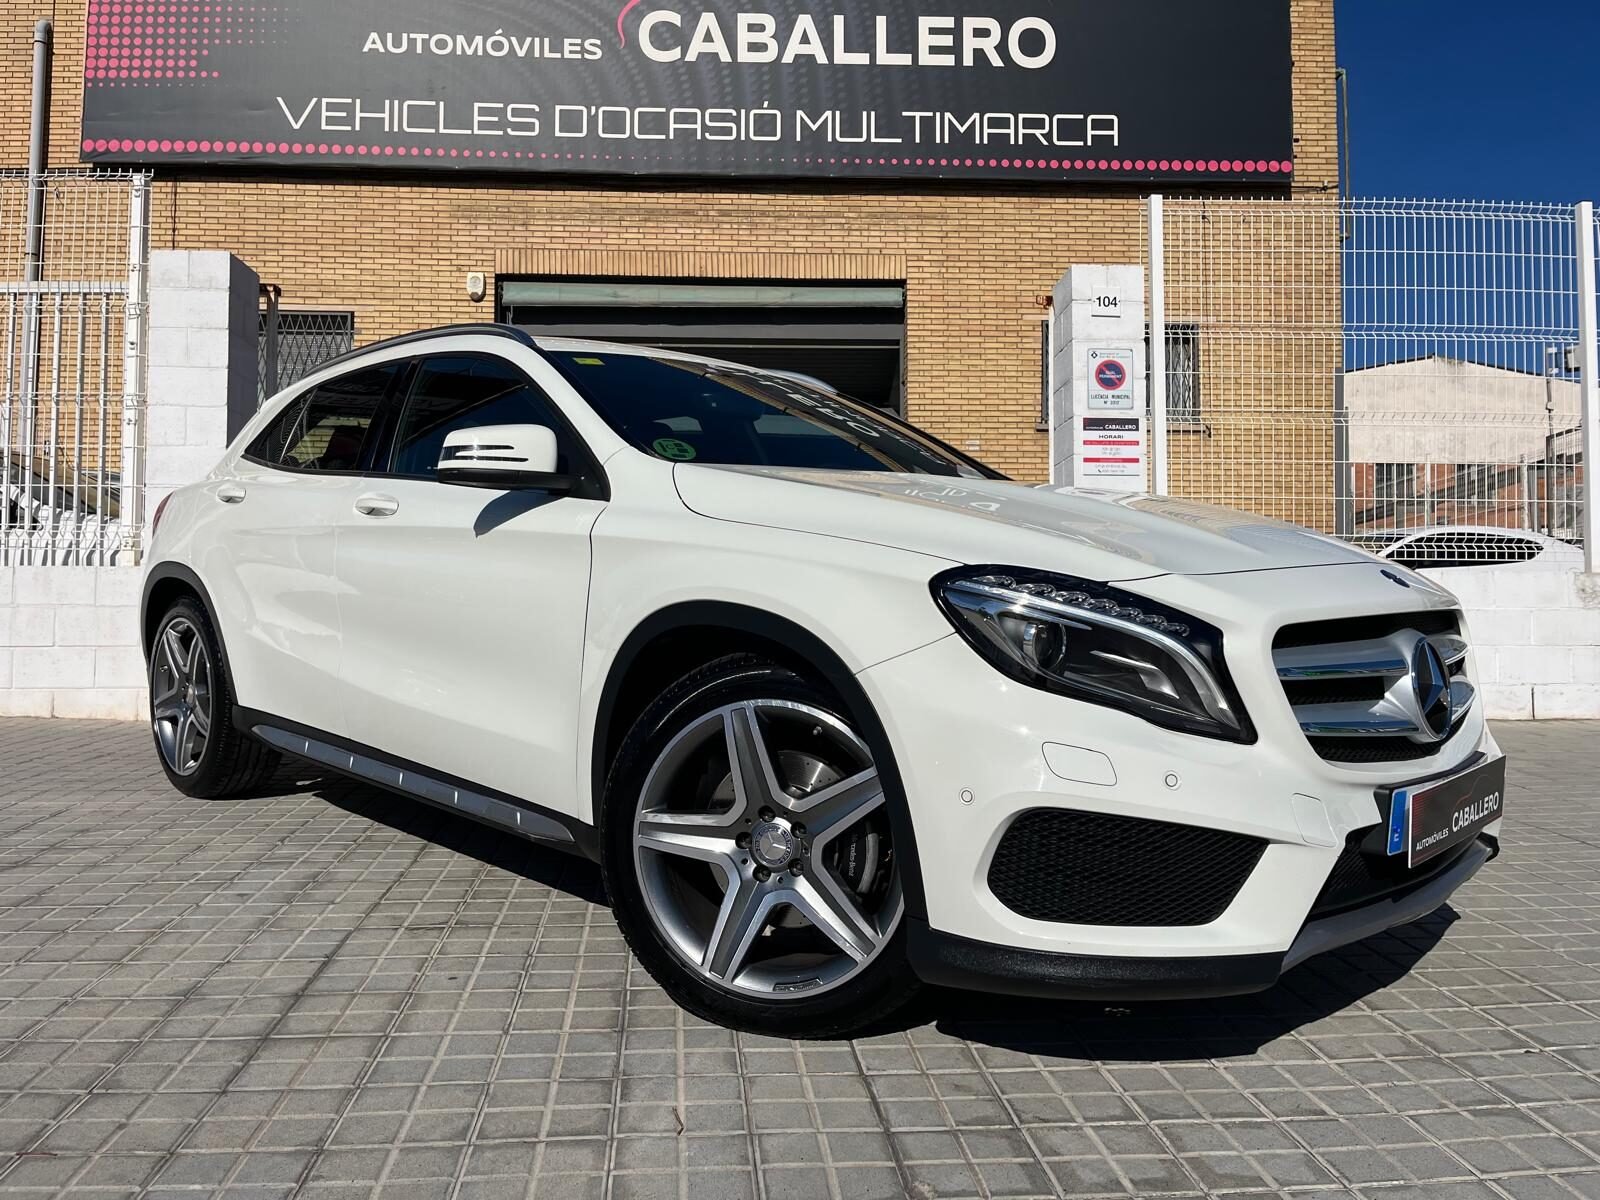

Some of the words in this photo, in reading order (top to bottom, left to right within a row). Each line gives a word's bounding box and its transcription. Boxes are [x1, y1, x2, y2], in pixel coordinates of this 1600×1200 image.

[361, 28, 603, 60] AUTOMÓVILES
[638, 9, 1057, 69] CABALLERO
[276, 96, 540, 137] VEHICLES
[554, 100, 782, 141] D'OCASIÓ
[796, 109, 1119, 146] MULTIMARCA
[1096, 295, 1118, 308] 104
[1416, 827, 1449, 850] AUTOMÓVILES
[1452, 791, 1500, 832] CABALLERO
